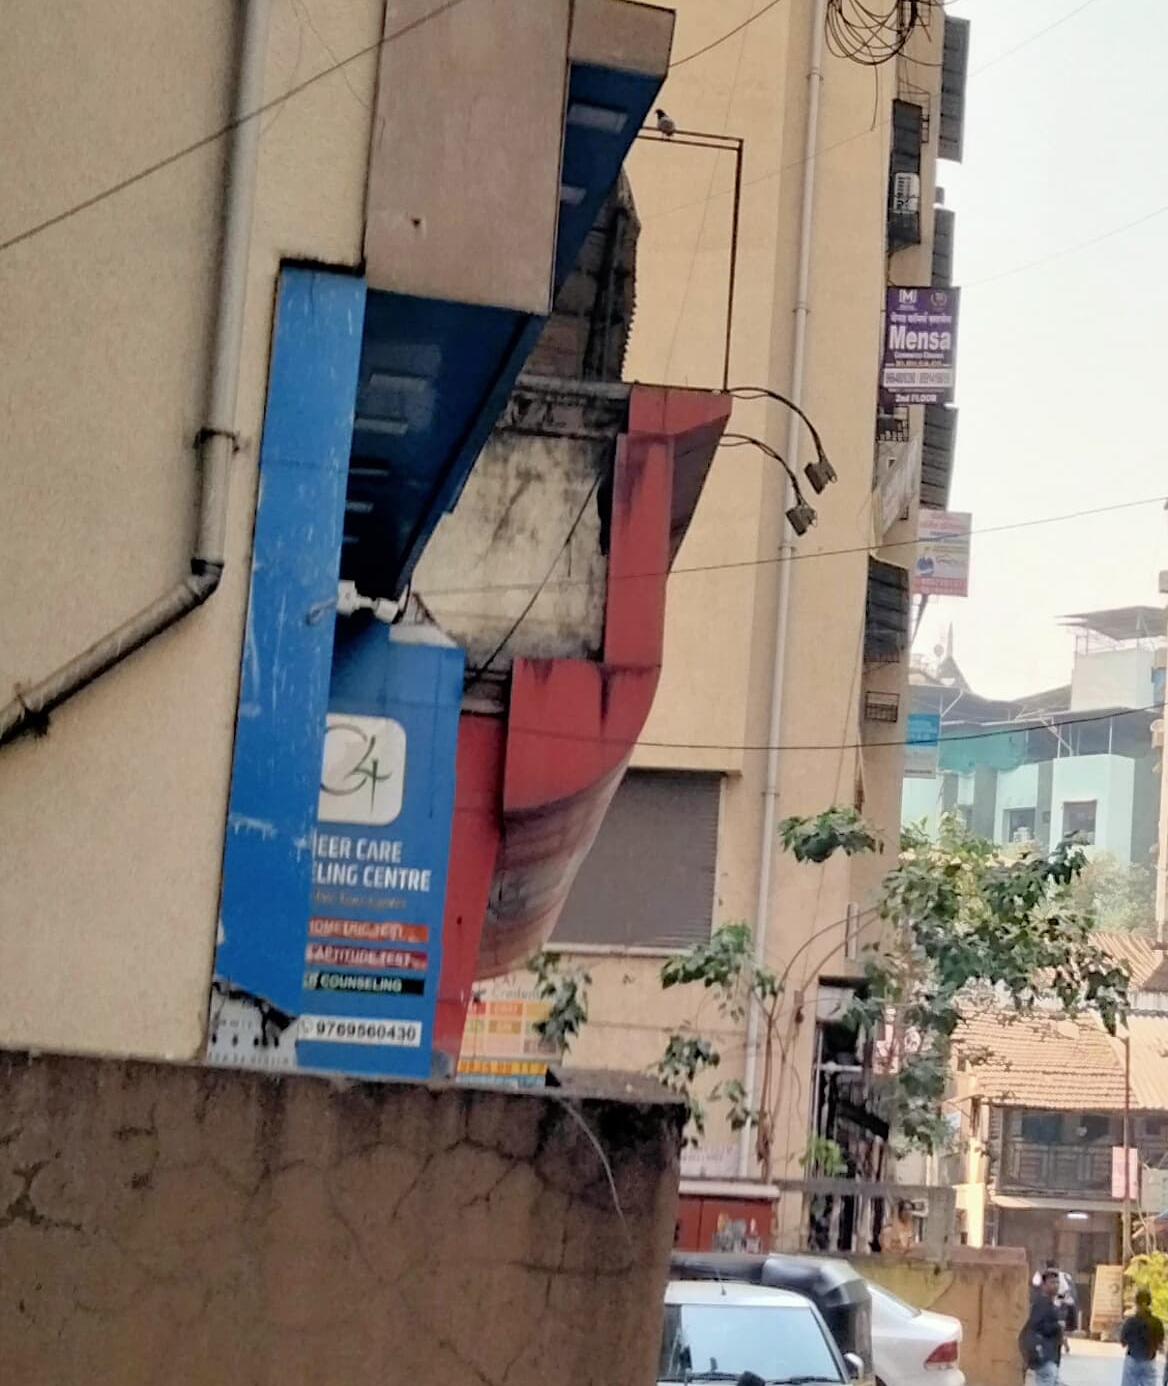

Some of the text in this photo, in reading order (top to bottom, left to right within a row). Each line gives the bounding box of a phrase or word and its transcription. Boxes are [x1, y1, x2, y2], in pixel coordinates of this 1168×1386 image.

[889, 324, 951, 350] Mensa
[356, 838, 402, 863] CARE
[362, 864, 432, 892] CENTRE
[320, 973, 402, 992] COUNSELING
